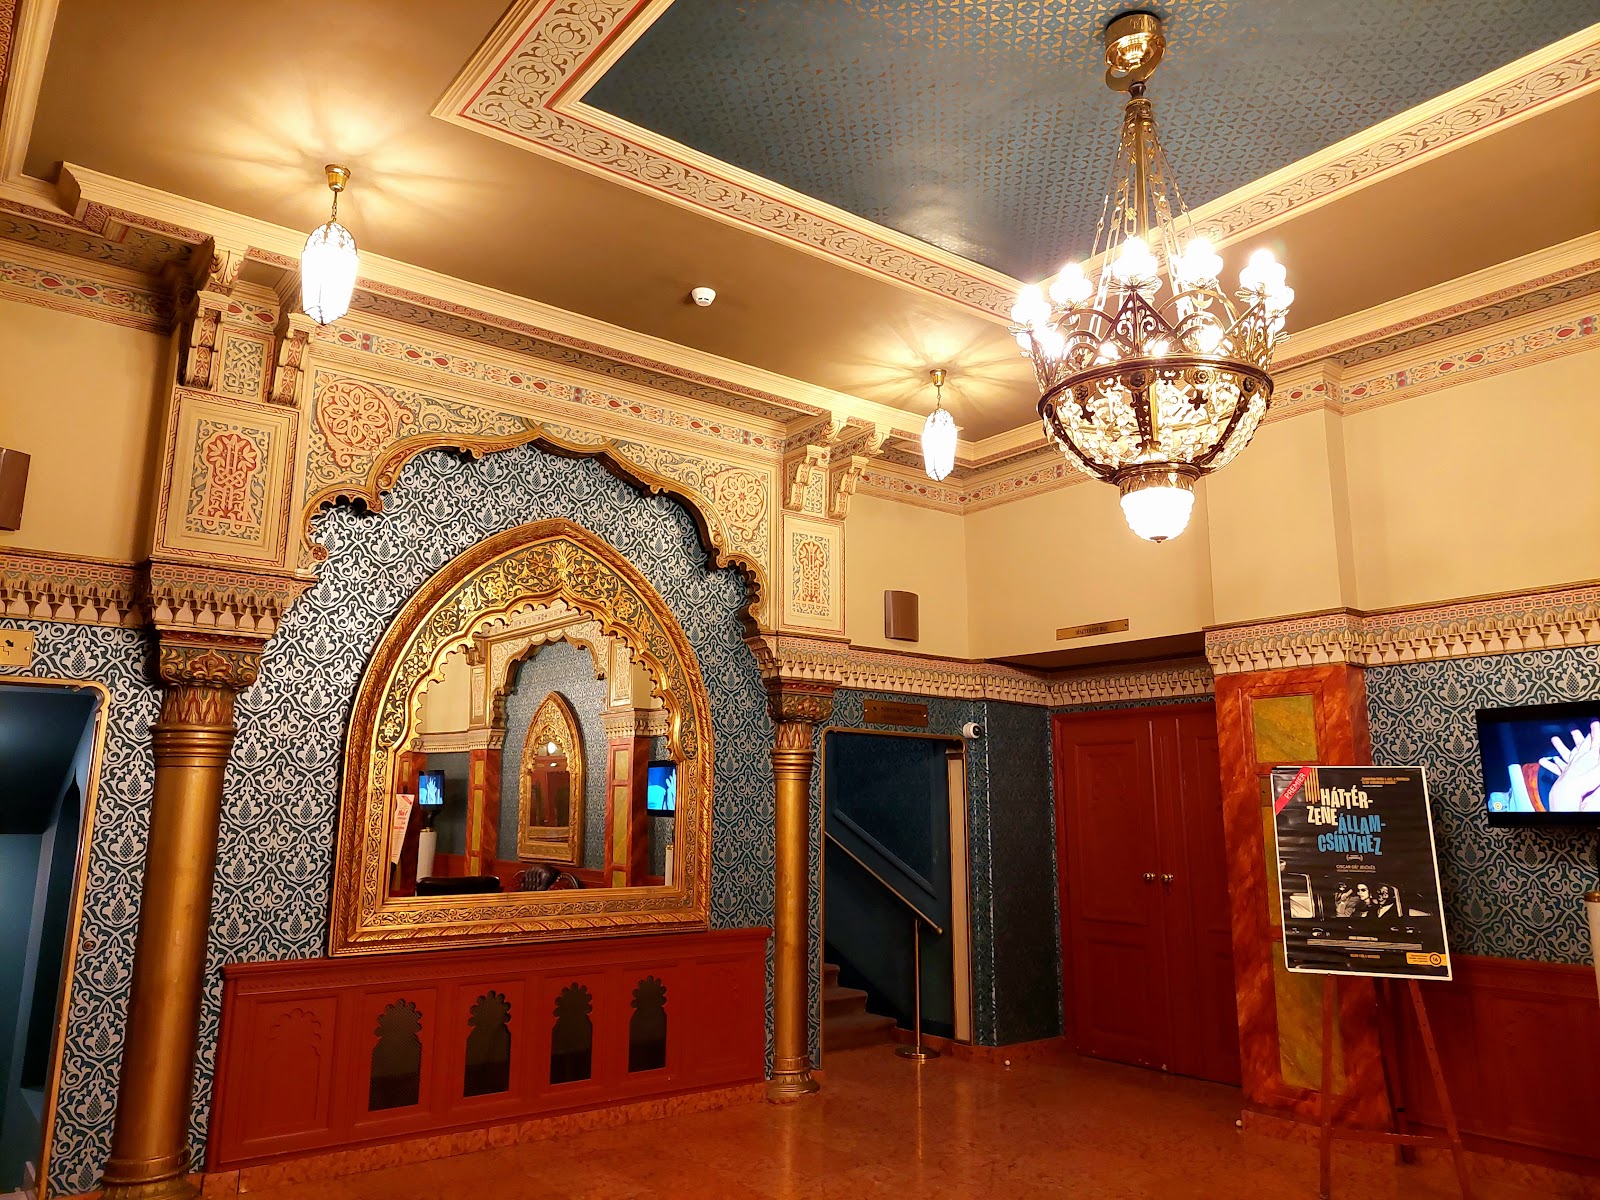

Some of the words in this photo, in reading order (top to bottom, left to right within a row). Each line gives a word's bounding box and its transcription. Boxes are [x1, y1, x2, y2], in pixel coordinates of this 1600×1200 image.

[1284, 772, 1307, 799] PREMIER
[1320, 785, 1373, 809] HÁTTÉR-
[1306, 806, 1338, 826] ZENE
[1338, 813, 1386, 835] ÁLLAM-
[1317, 831, 1383, 855] CSÍNYHEZ
